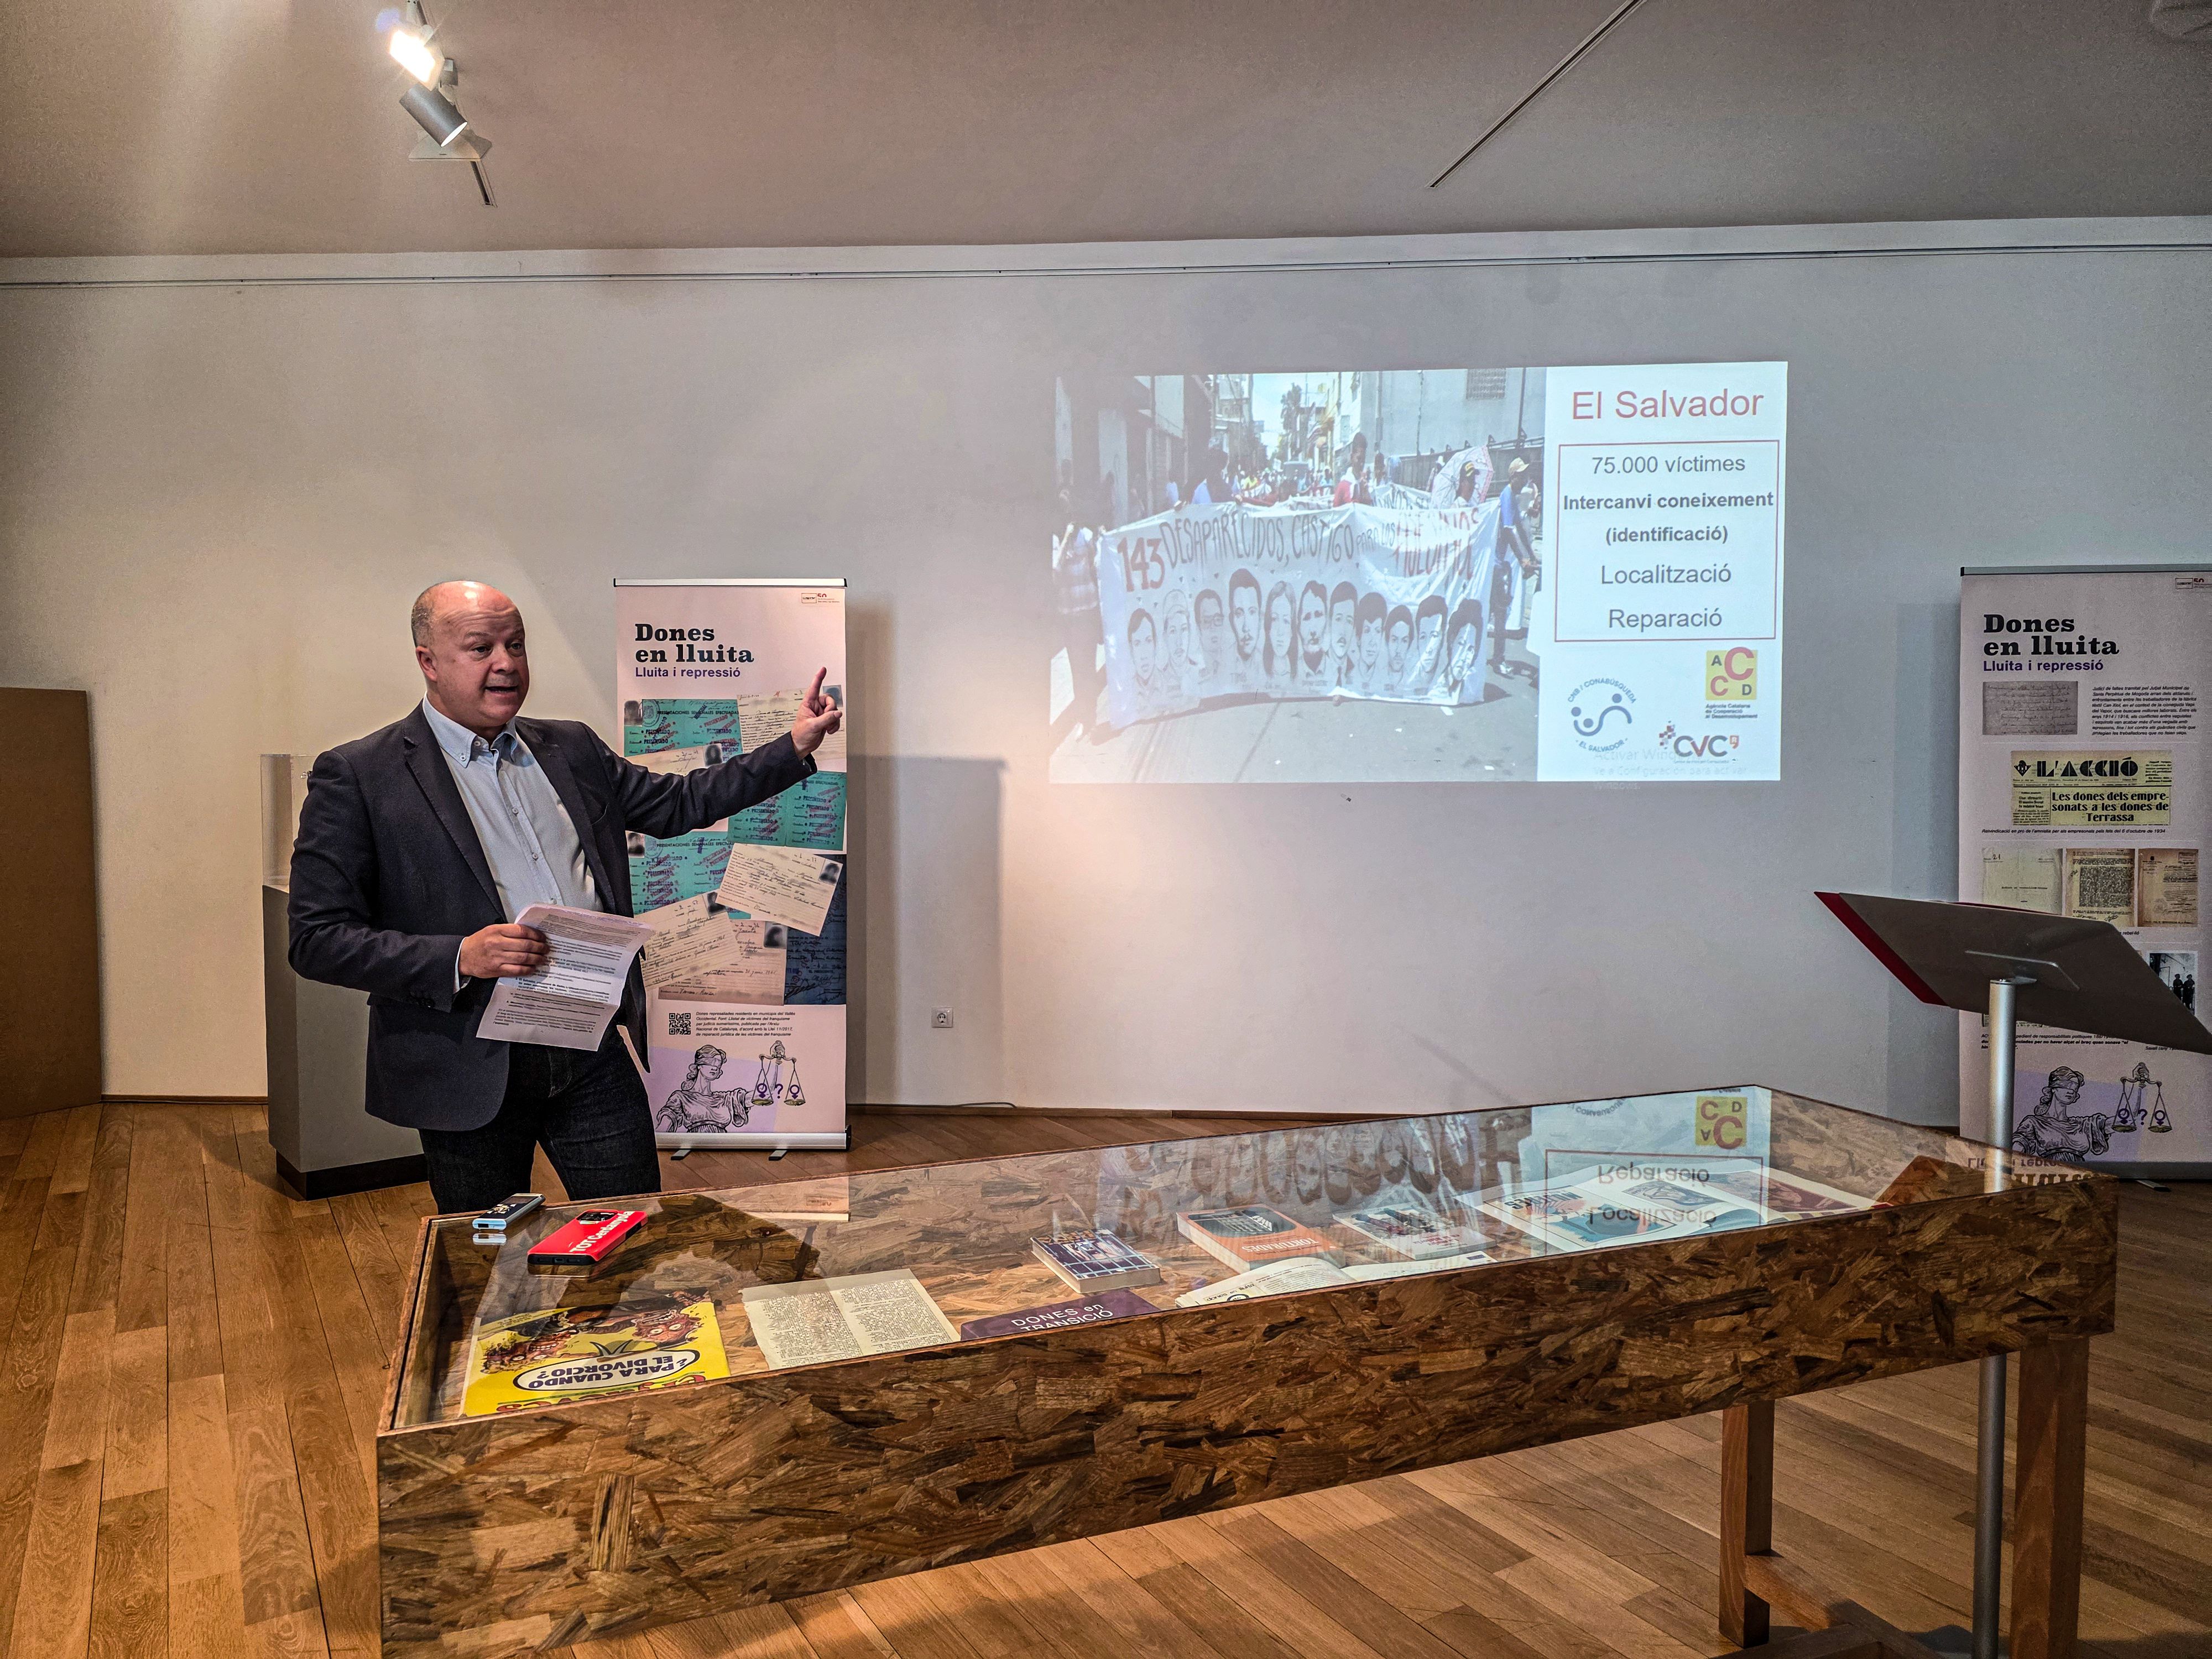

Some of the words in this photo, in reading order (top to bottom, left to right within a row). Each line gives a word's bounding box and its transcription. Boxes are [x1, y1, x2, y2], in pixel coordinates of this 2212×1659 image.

[1572, 391, 1601, 420] El
[1615, 388, 1764, 418] Salvador
[1592, 456, 1658, 474] 75.000
[1665, 454, 1745, 472] víctimes
[1563, 494, 1652, 510] Intercanvi
[1657, 492, 1774, 508] coneixement
[1606, 525, 1728, 546] (identificació)
[1117, 537, 1165, 592] 143
[1291, 515, 1354, 566] CASTIGO
[1601, 564, 1732, 585] Localització
[1609, 608, 1723, 633] Reparació
[1984, 614, 2075, 633] Dones
[635, 623, 714, 641] Dones
[635, 649, 667, 662] en
[676, 644, 754, 662] lluita
[1984, 641, 2021, 655] en
[2031, 635, 2119, 655] lluita
[635, 667, 669, 677] Lluita
[673, 667, 676, 677] i
[681, 666, 740, 679] repressió
[1984, 661, 2022, 671] Lluita
[2028, 661, 2032, 671] i
[2037, 660, 2104, 673] repressió
[1673, 735, 1728, 757] CVC
[2037, 757, 2138, 777] L'ACCIÓ
[2052, 792, 2070, 801] Les
[2073, 792, 2105, 801] dones
[2106, 792, 2129, 801] dels
[2130, 792, 2169, 802] empre-
[2052, 802, 2088, 811] sonats
[2101, 802, 2117, 811] les
[2120, 802, 2152, 811] dones
[2156, 802, 2169, 811] de
[2085, 813, 2134, 822] Terrassa
[569, 1239, 596, 1253] TOT
[587, 1211, 635, 1239] Cerdanyola
[1241, 1237, 1320, 1254] TORTURADES
[1011, 1308, 1078, 1327] DONES
[1084, 1303, 1104, 1313] en
[1020, 1308, 1114, 1332] TRANSICIÓ
[536, 1358, 648, 1379] DIVORCIO?
[651, 1355, 674, 1365] EL
[528, 1373, 613, 1389] CUANDO
